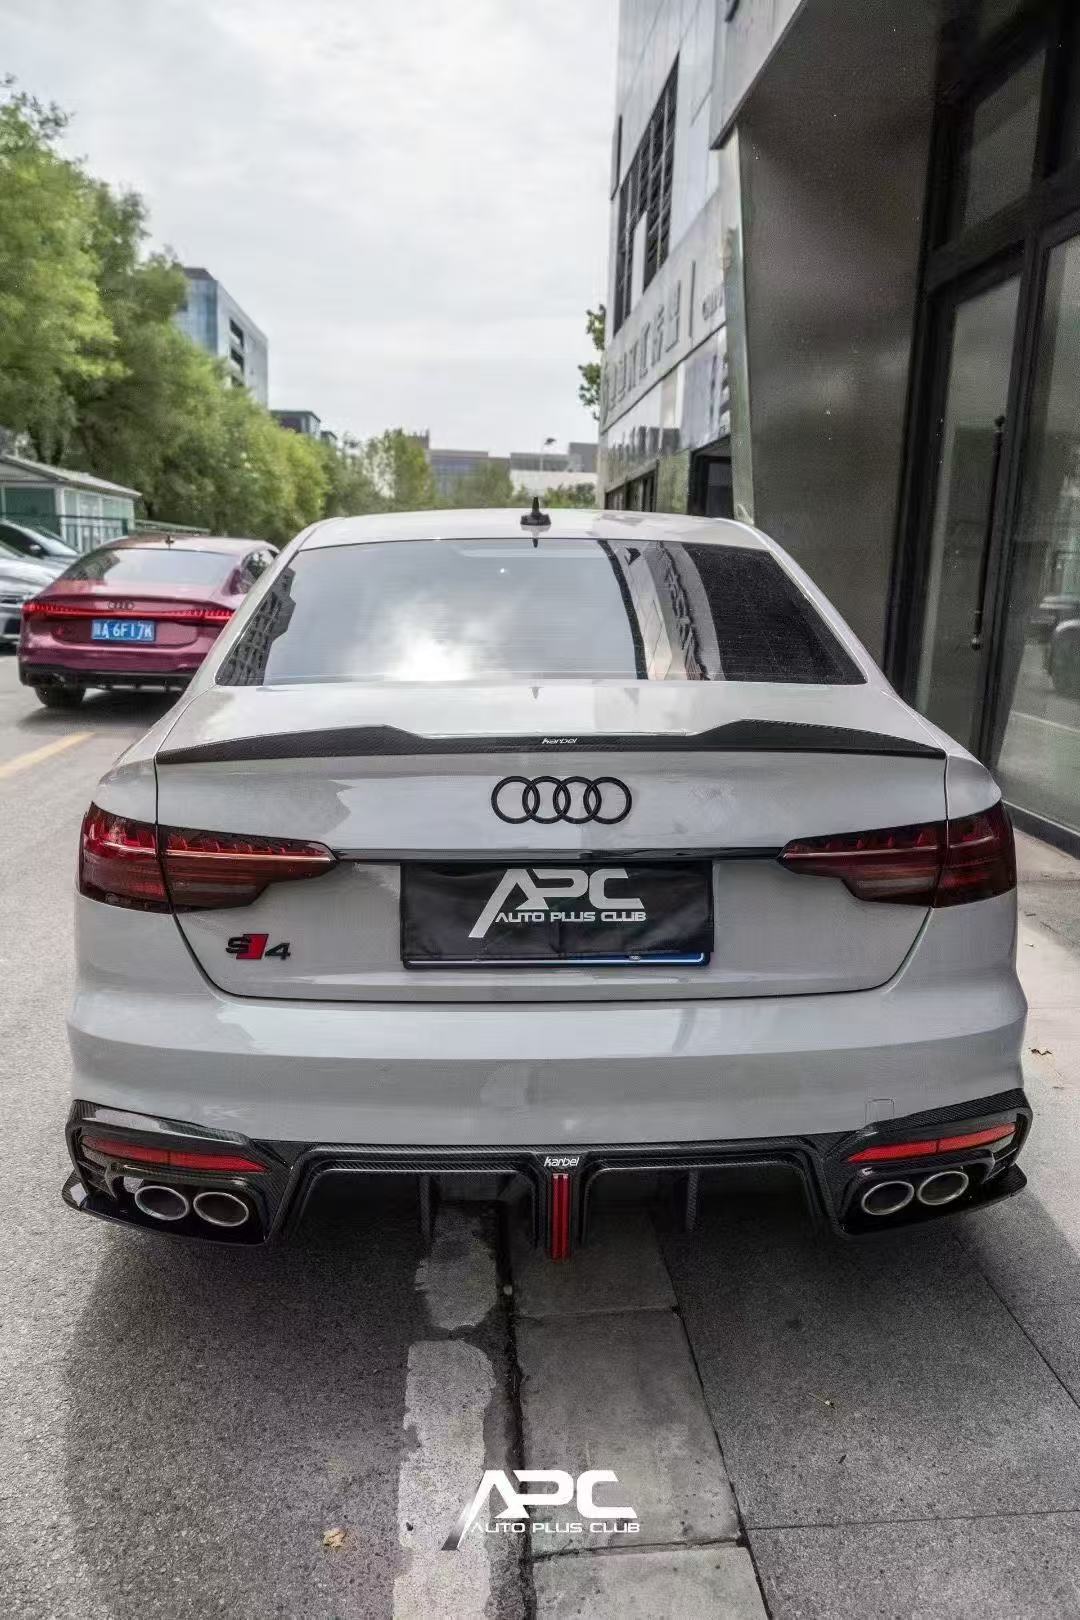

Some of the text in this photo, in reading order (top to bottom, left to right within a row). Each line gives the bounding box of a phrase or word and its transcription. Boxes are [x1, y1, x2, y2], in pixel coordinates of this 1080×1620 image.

[467, 868, 645, 939] APC
[495, 911, 647, 923] AUTO PLUS CLUB
[543, 1156, 580, 1167] karbel
